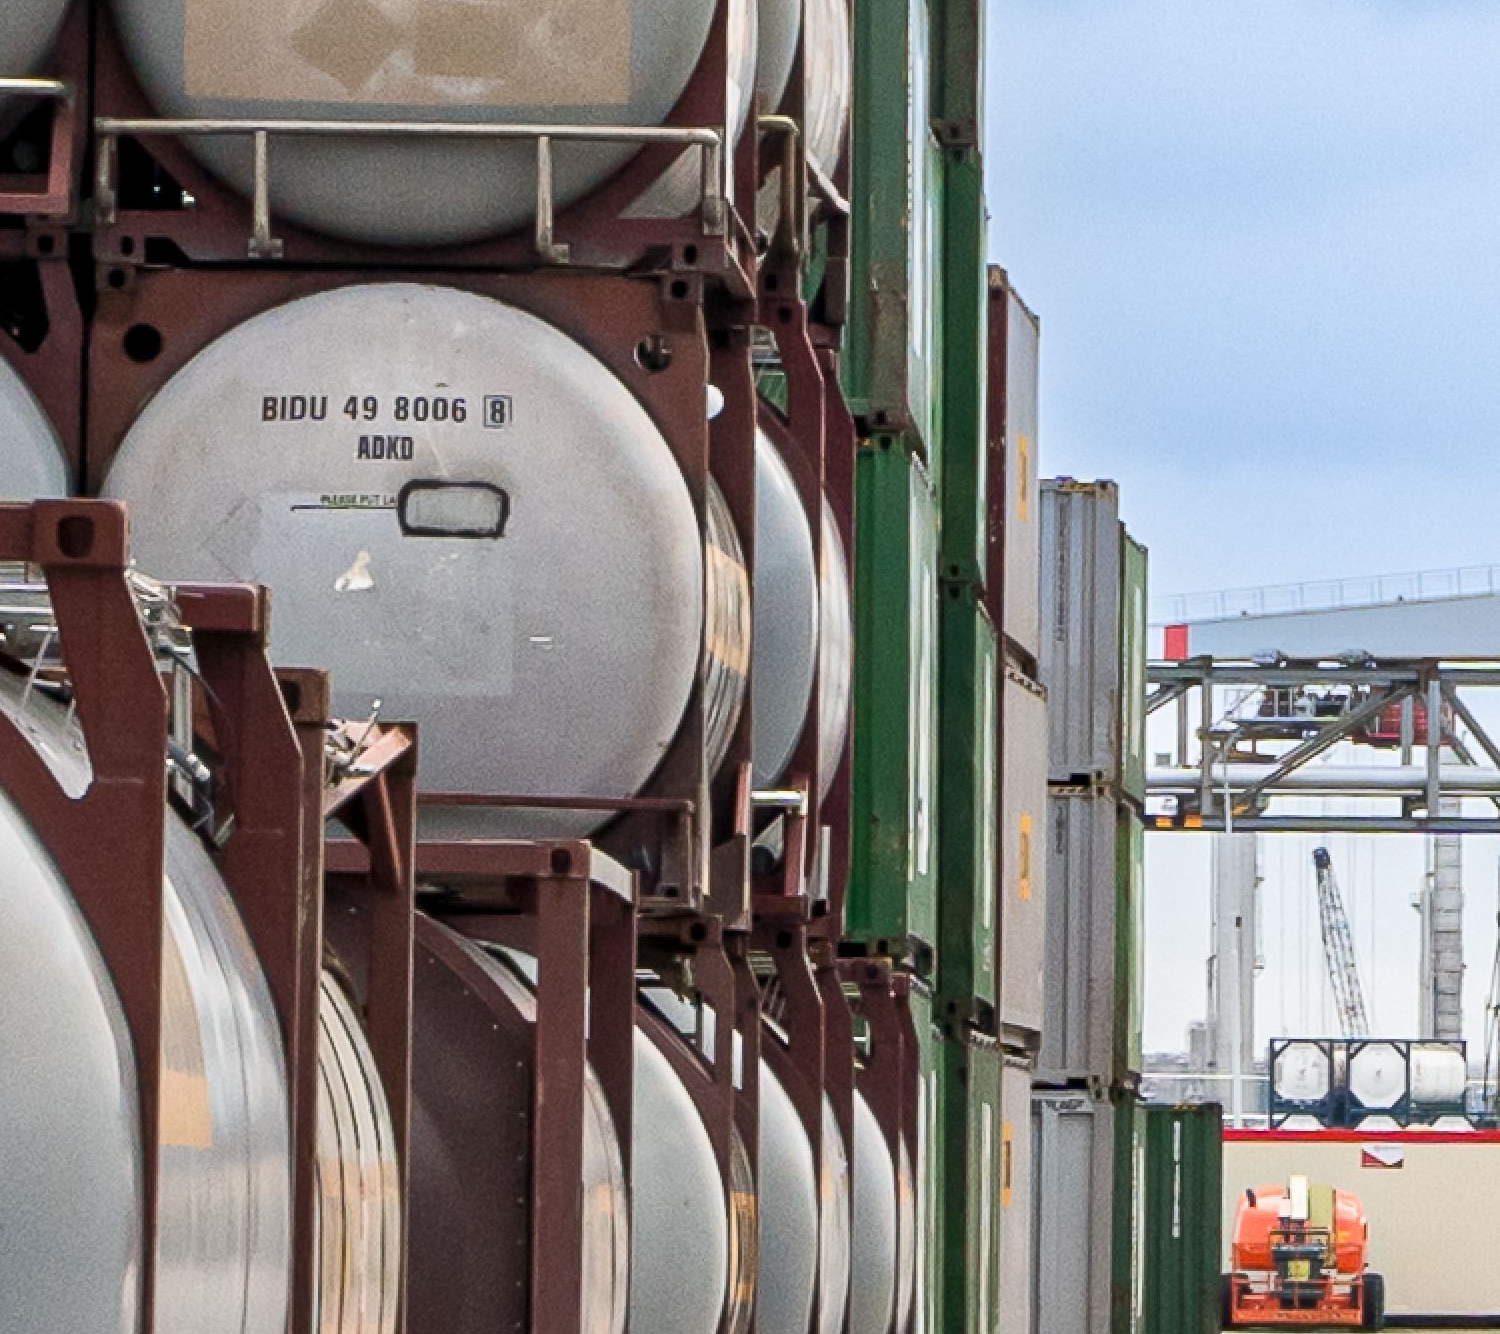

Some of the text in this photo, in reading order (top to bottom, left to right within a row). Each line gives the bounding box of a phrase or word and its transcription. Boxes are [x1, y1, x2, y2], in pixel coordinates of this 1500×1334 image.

[262, 396, 506, 425] BIDU 49 8006 8
[356, 435, 415, 460] ADKD
